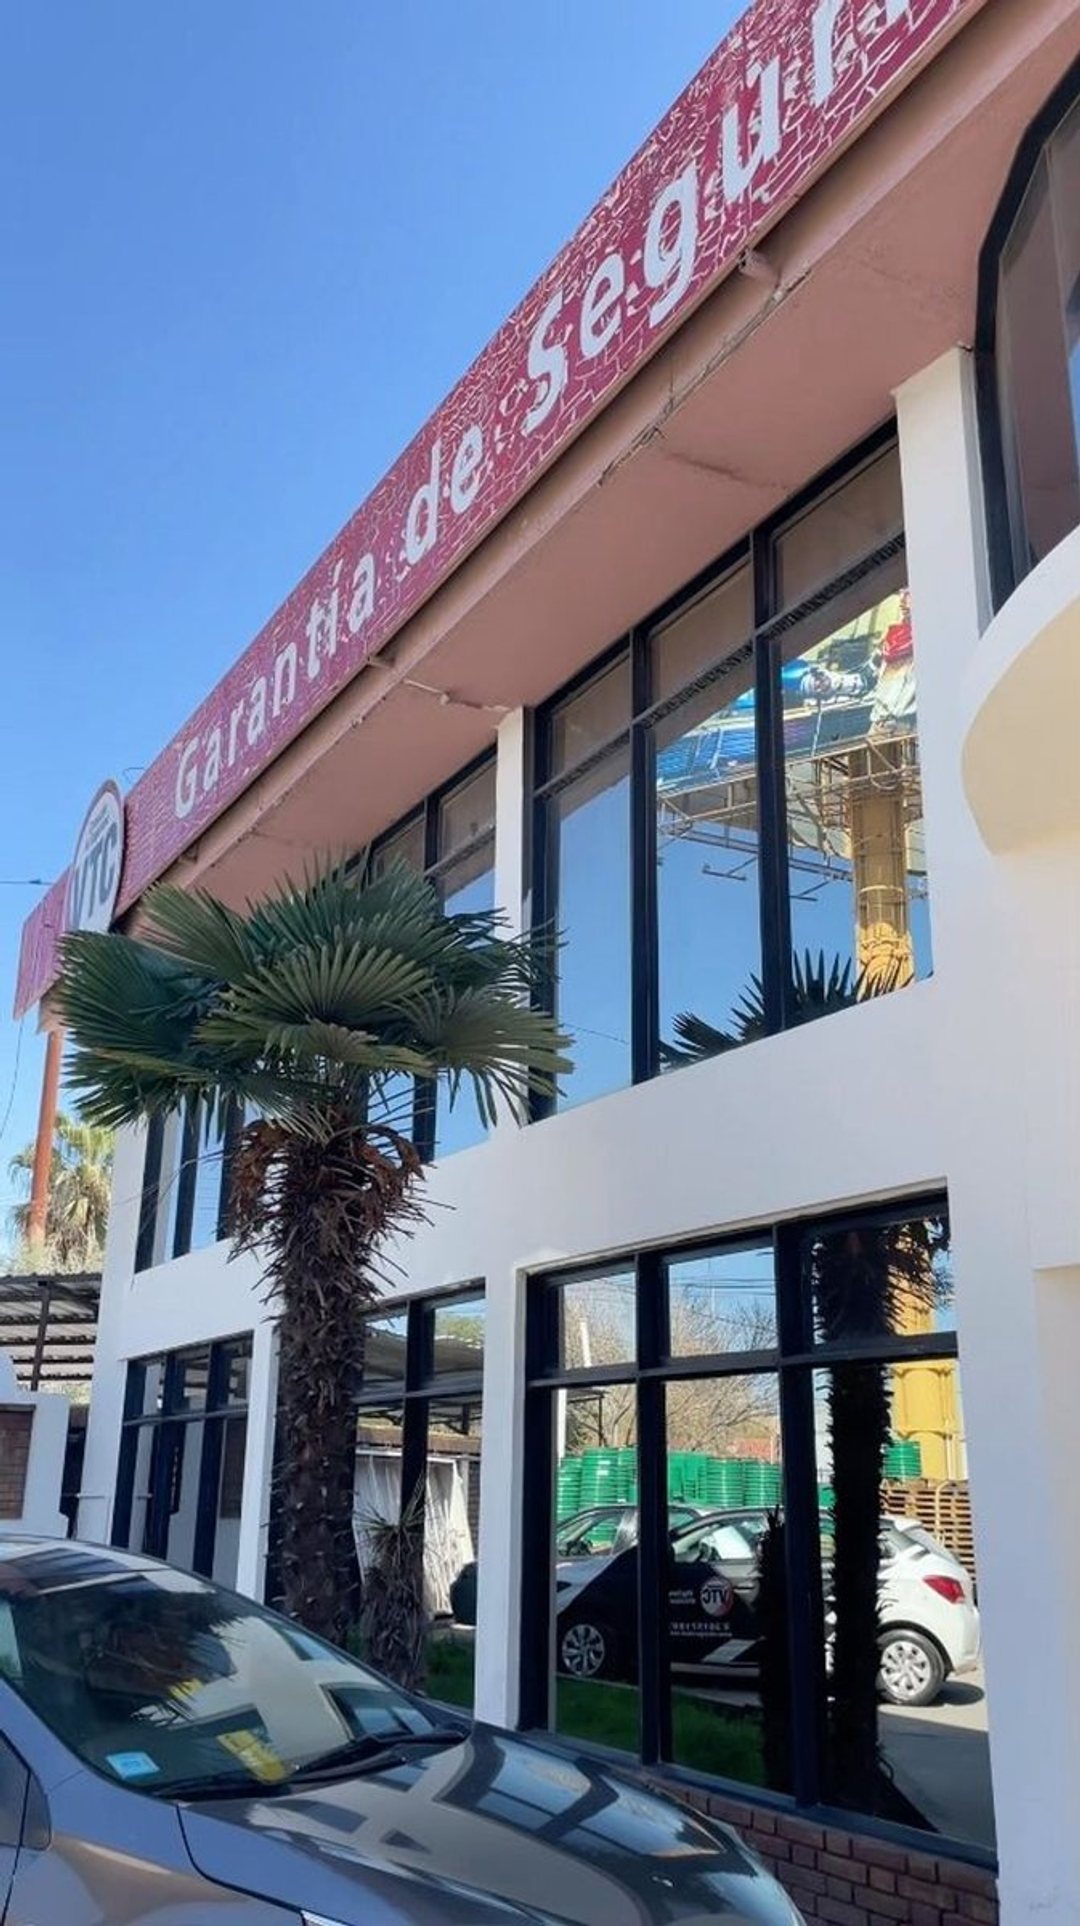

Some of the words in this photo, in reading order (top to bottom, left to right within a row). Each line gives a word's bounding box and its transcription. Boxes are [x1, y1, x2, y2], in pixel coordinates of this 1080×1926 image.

[174, 553, 376, 820] Garantía
[403, 423, 483, 566] de
[522, 0, 910, 434] Segur
